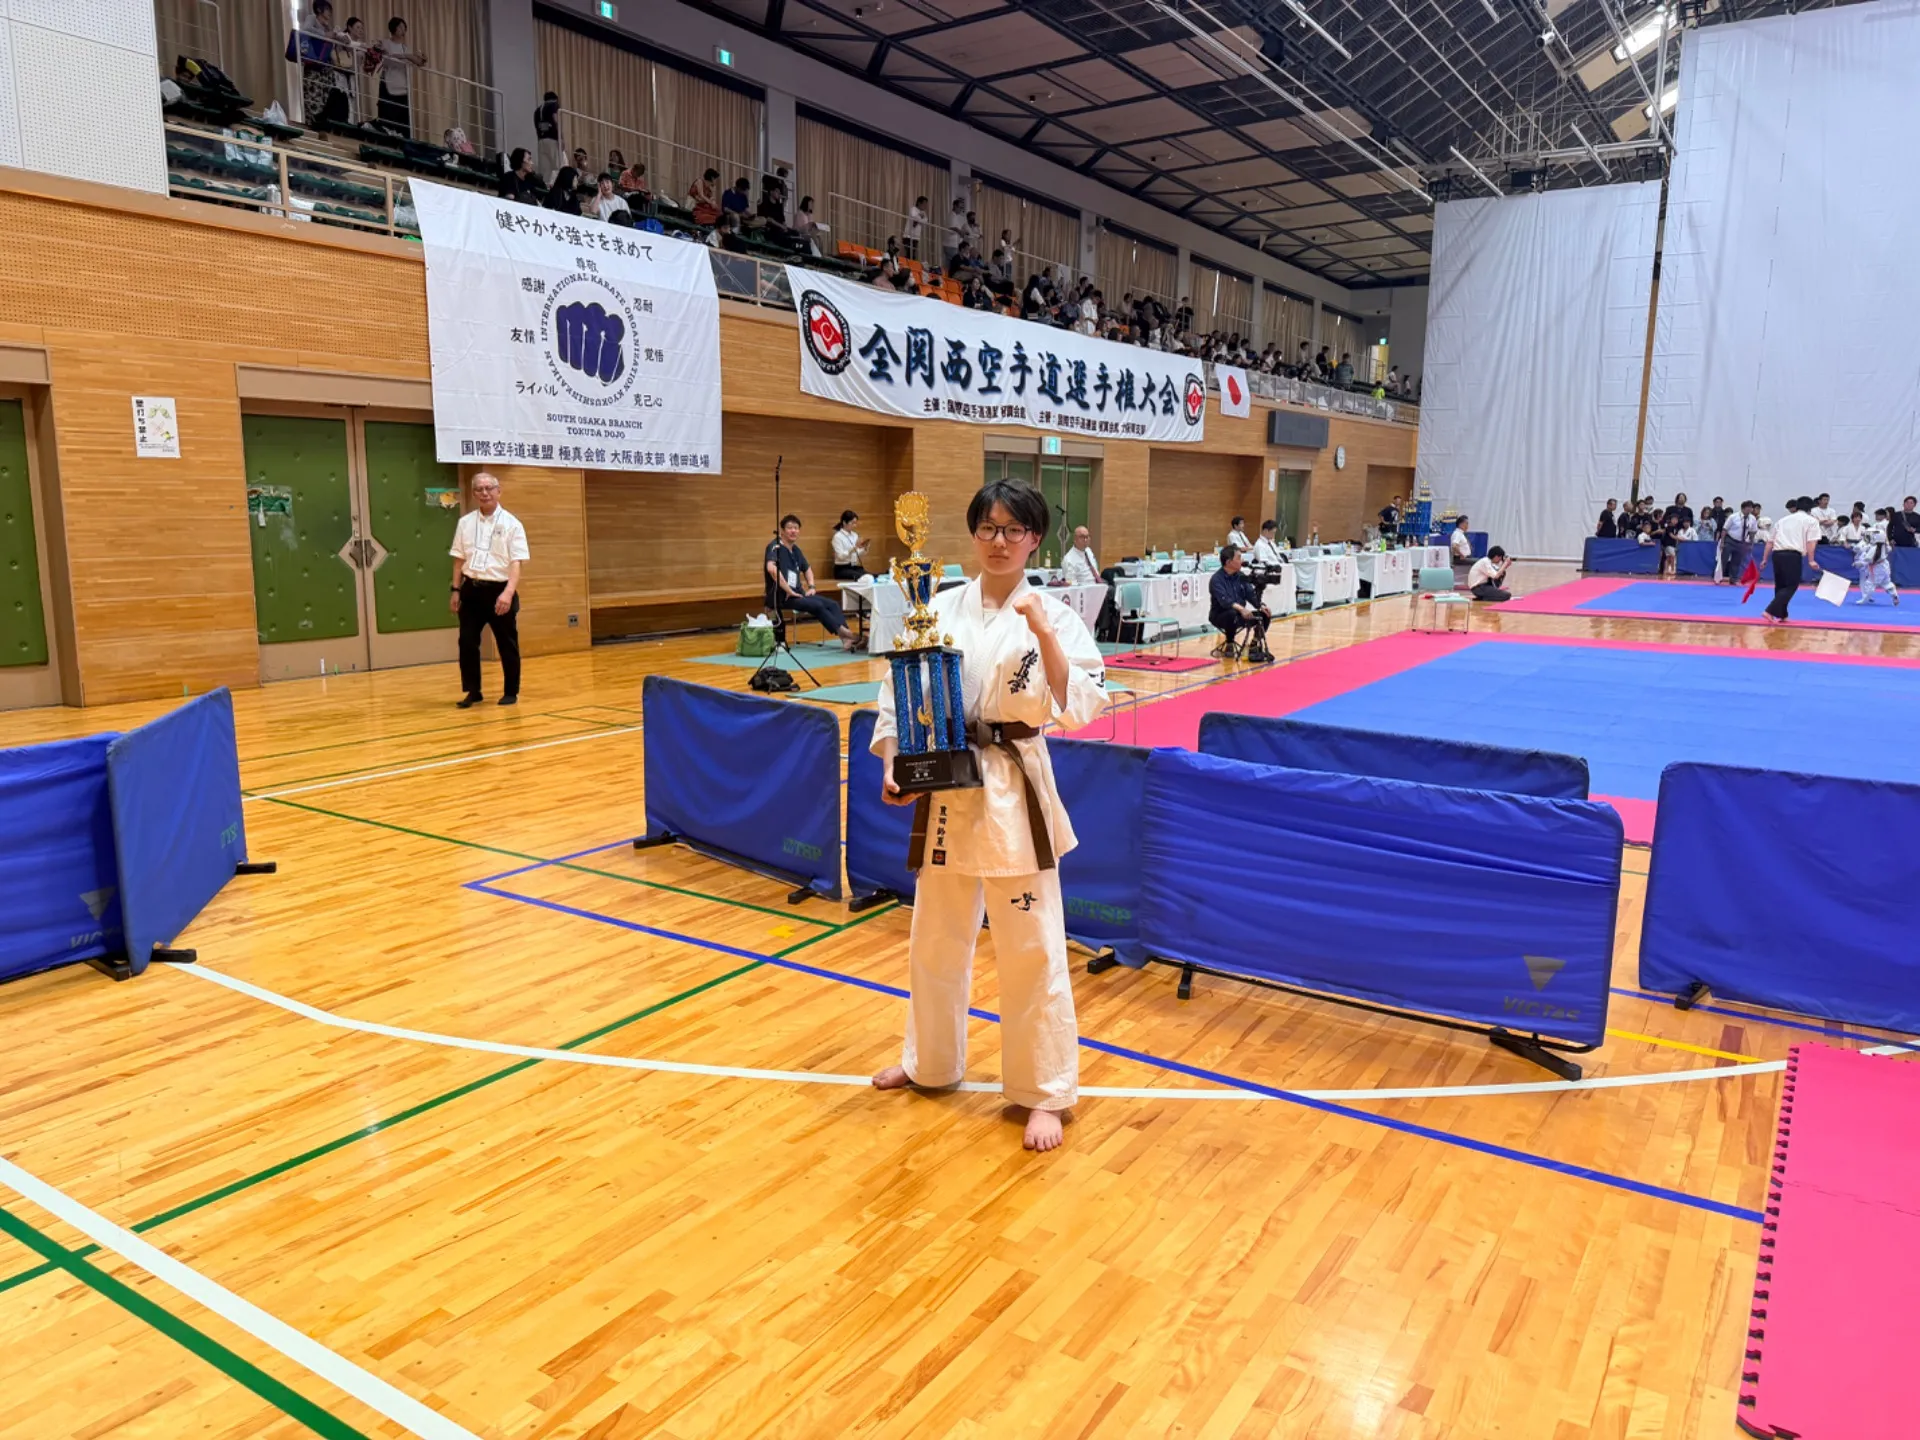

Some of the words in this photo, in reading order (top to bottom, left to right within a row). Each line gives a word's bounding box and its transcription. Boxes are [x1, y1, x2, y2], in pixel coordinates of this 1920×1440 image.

[496, 209, 653, 261] 健やかな強さを求めて
[521, 277, 545, 294] 感謝
[510, 327, 536, 344] 友情
[541, 273, 589, 342] INTERNATIONAL
[591, 273, 626, 306] KARATE
[623, 307, 639, 391] ORGANIZATION
[644, 348, 664, 363] 覚悟
[858, 323, 1181, 416] 全関西空手道選手権大会
[515, 381, 559, 397] ライバル
[633, 393, 663, 407] 克己心
[547, 412, 576, 424] SOUTH
[577, 416, 607, 427] OSAKA
[609, 418, 643, 430] BRANCH
[567, 426, 602, 437] TOKUDA
[604, 429, 626, 439] DOJO
[461, 440, 555, 460] 国際空手道連盟
[558, 445, 606, 463] 極真会館
[610, 450, 665, 466] 大阪南支部
[668, 452, 710, 469] 徳田道場
[1503, 995, 1581, 1022] VICTAS
